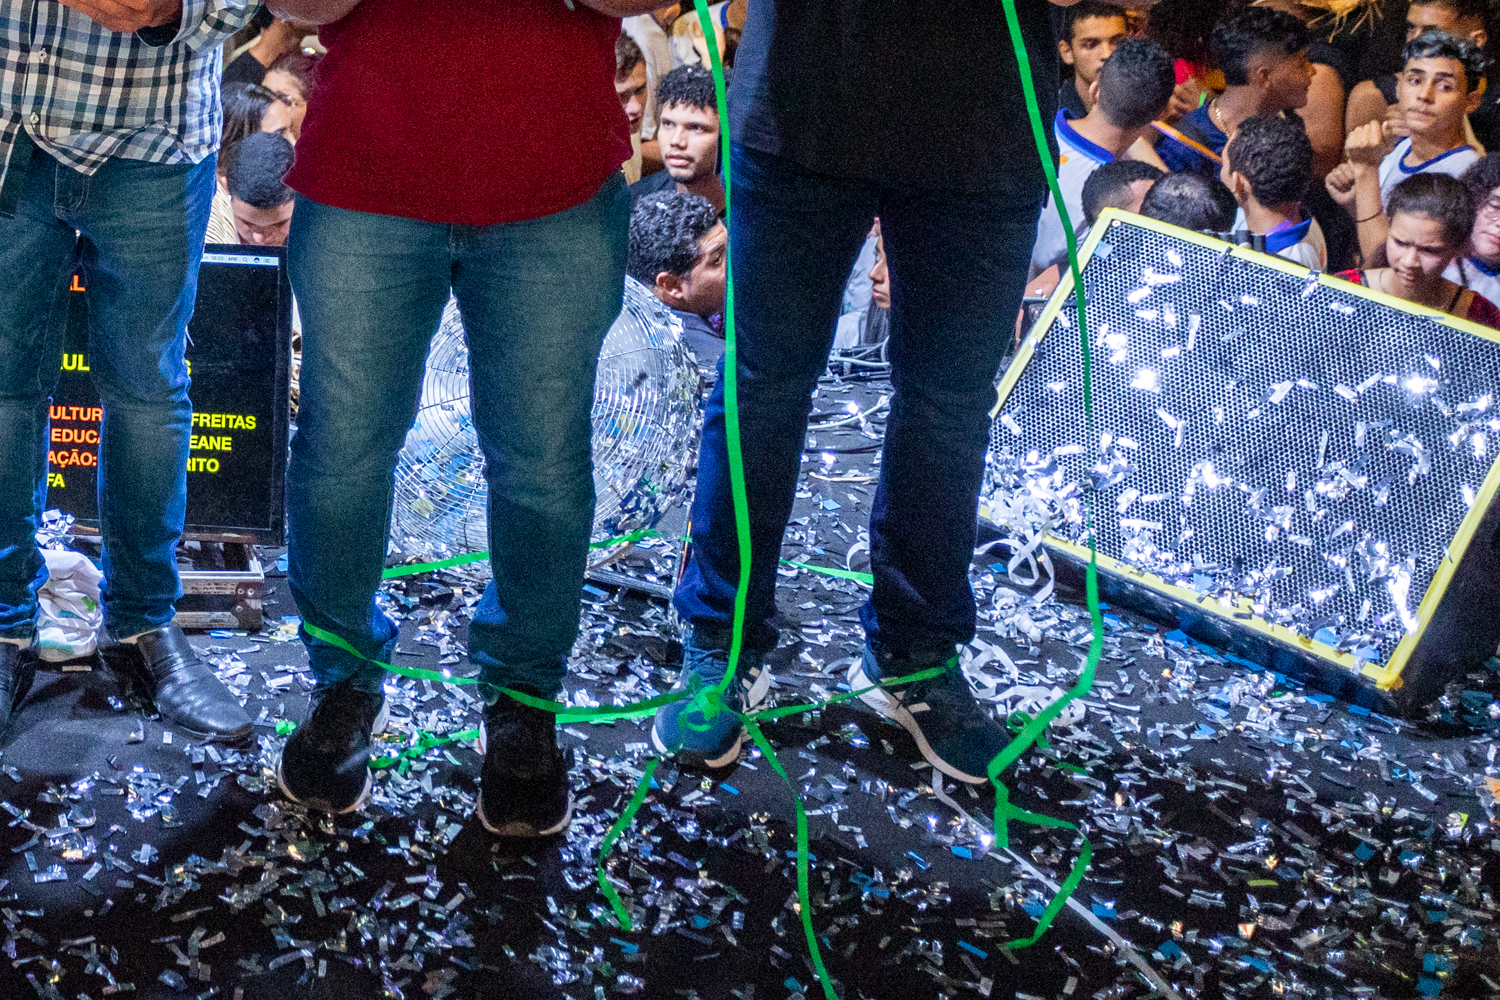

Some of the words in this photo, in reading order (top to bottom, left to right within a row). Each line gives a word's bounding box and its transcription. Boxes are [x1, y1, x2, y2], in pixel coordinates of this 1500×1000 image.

[69, 275, 86, 291] L
[60, 353, 90, 371] UL
[191, 413, 257, 429] FREITAS
[51, 428, 100, 444] EDUC
[189, 435, 232, 451] EANE
[47, 473, 65, 488] FA
